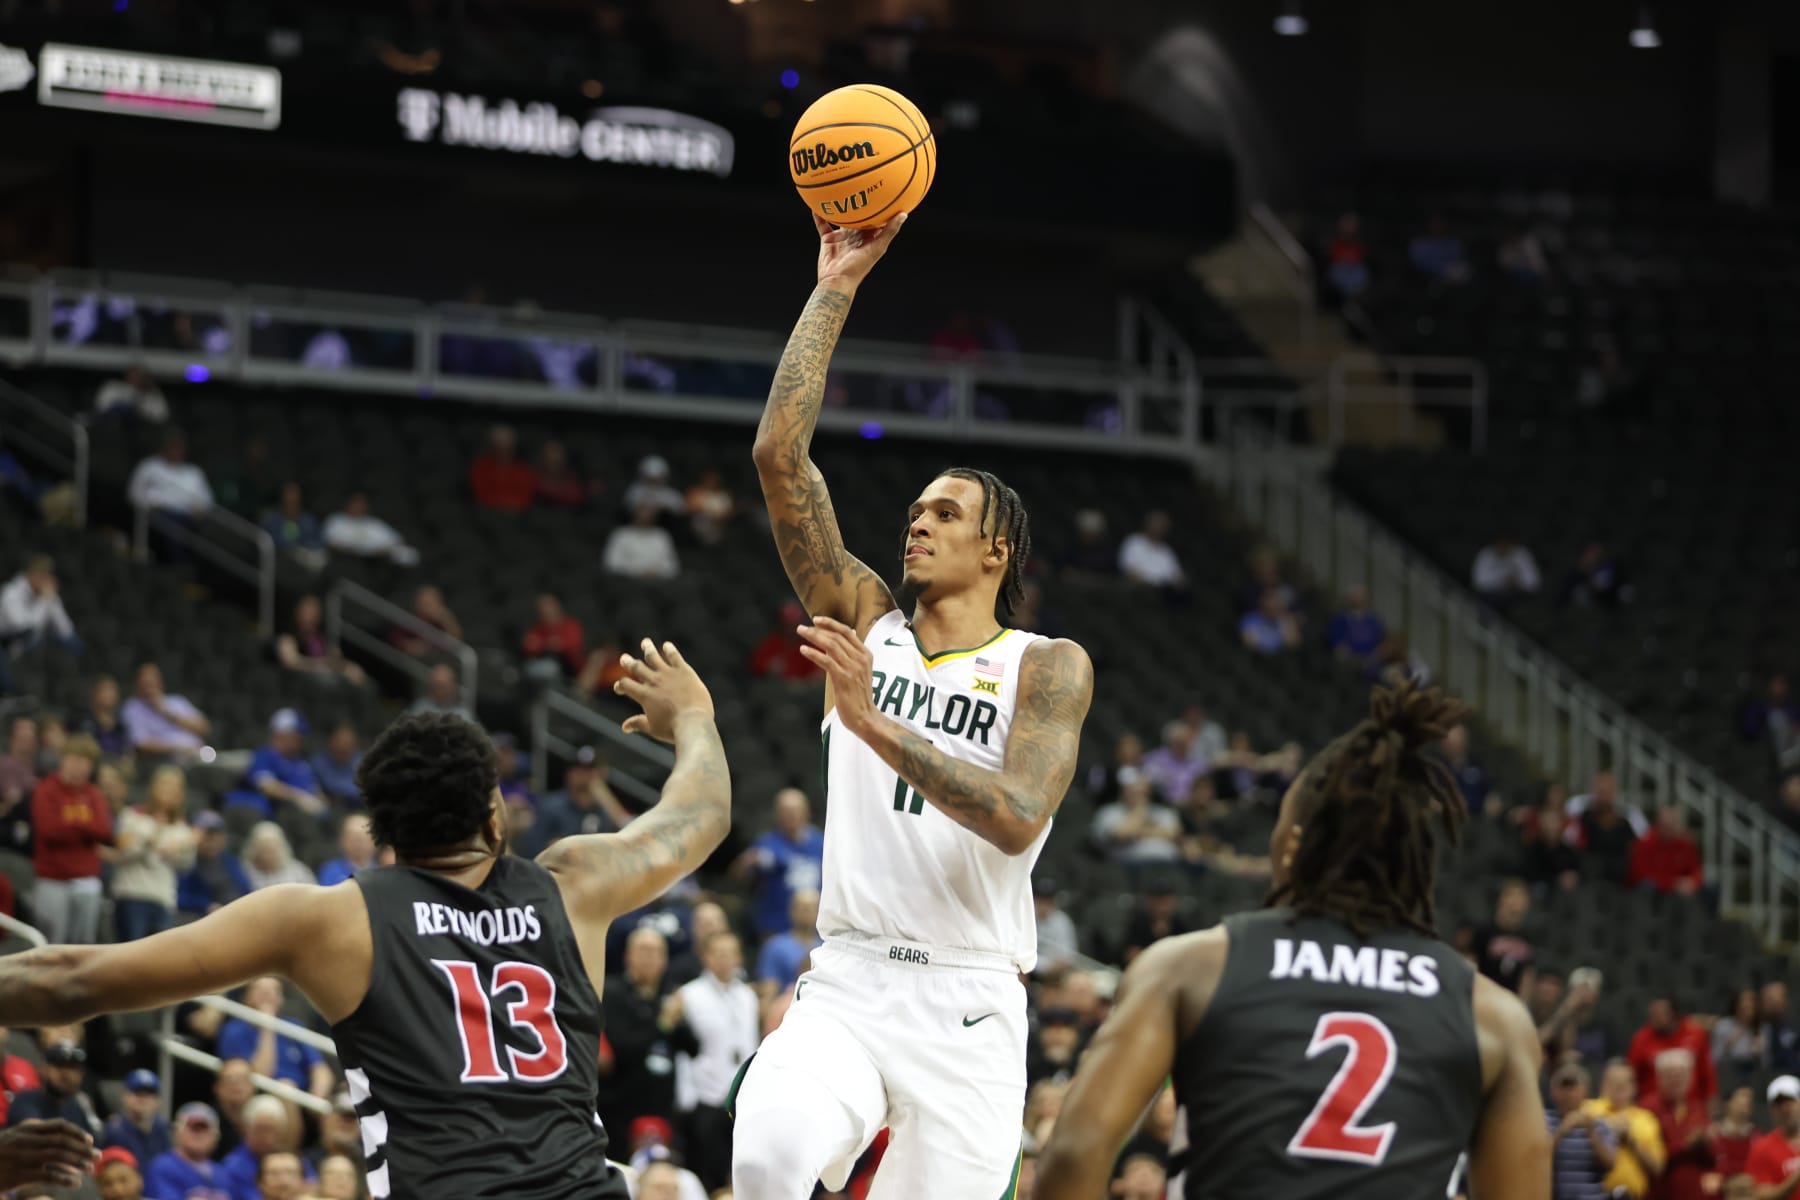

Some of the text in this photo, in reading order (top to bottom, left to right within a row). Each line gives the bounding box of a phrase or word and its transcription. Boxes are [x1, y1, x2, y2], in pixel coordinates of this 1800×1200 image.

[792, 141, 875, 176] Wilson
[413, 901, 541, 946] REYNOLDS
[889, 945, 930, 965] BEARS
[1269, 938, 1440, 997] JAMES
[430, 958, 568, 1083] 13
[1287, 1011, 1397, 1165] 2
